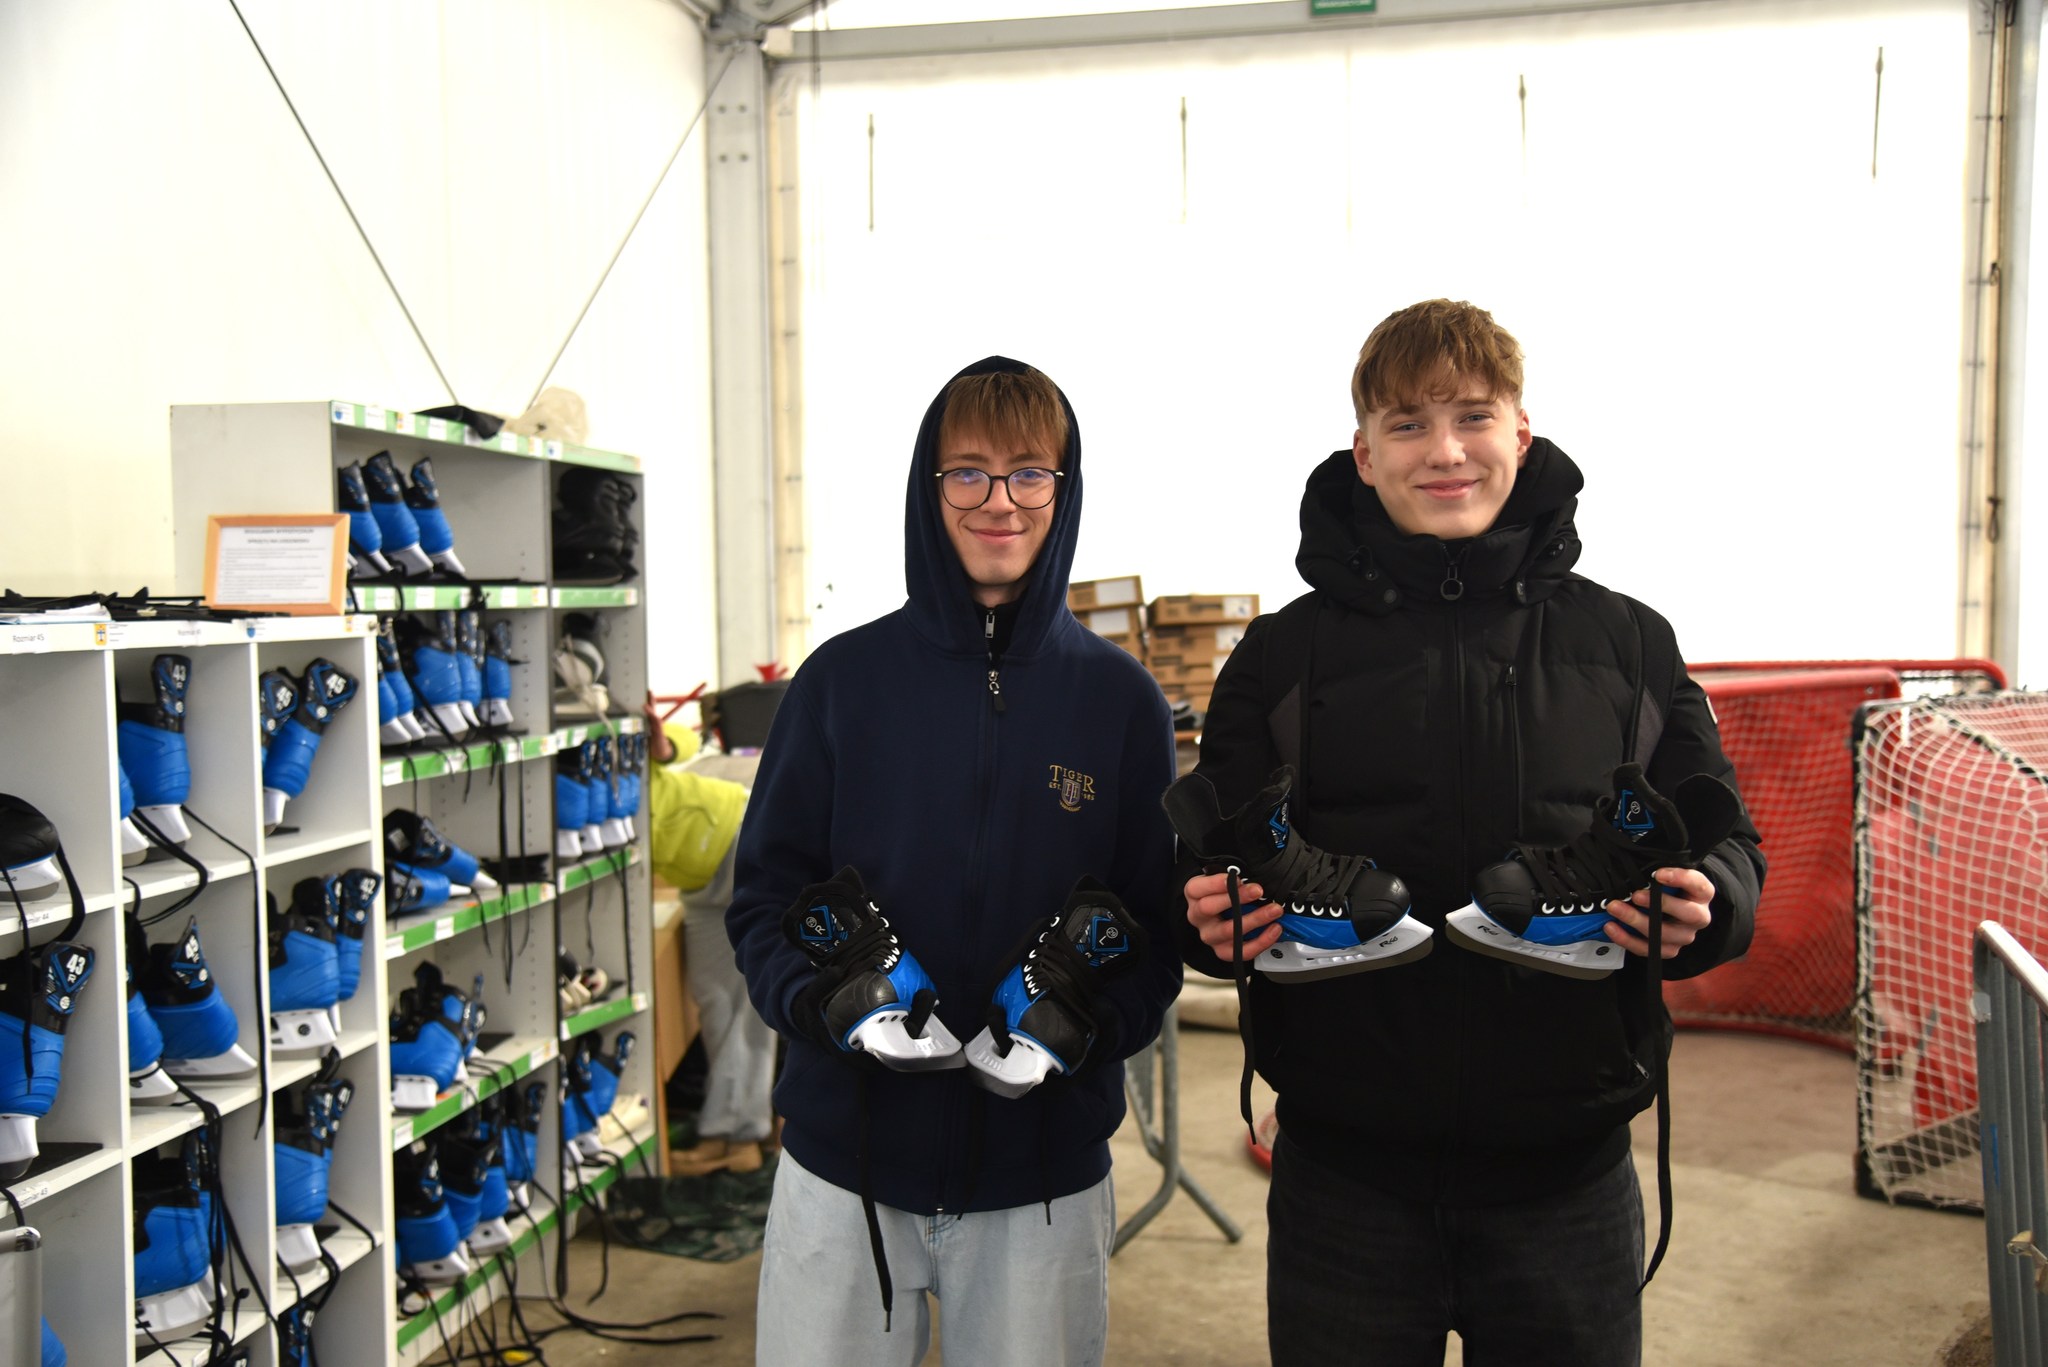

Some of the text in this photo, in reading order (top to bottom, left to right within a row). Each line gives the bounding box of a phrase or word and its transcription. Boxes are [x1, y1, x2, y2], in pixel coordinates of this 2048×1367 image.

[172, 665, 187, 683] 43
[325, 673, 347, 695] 45
[66, 953, 86, 976] 43
